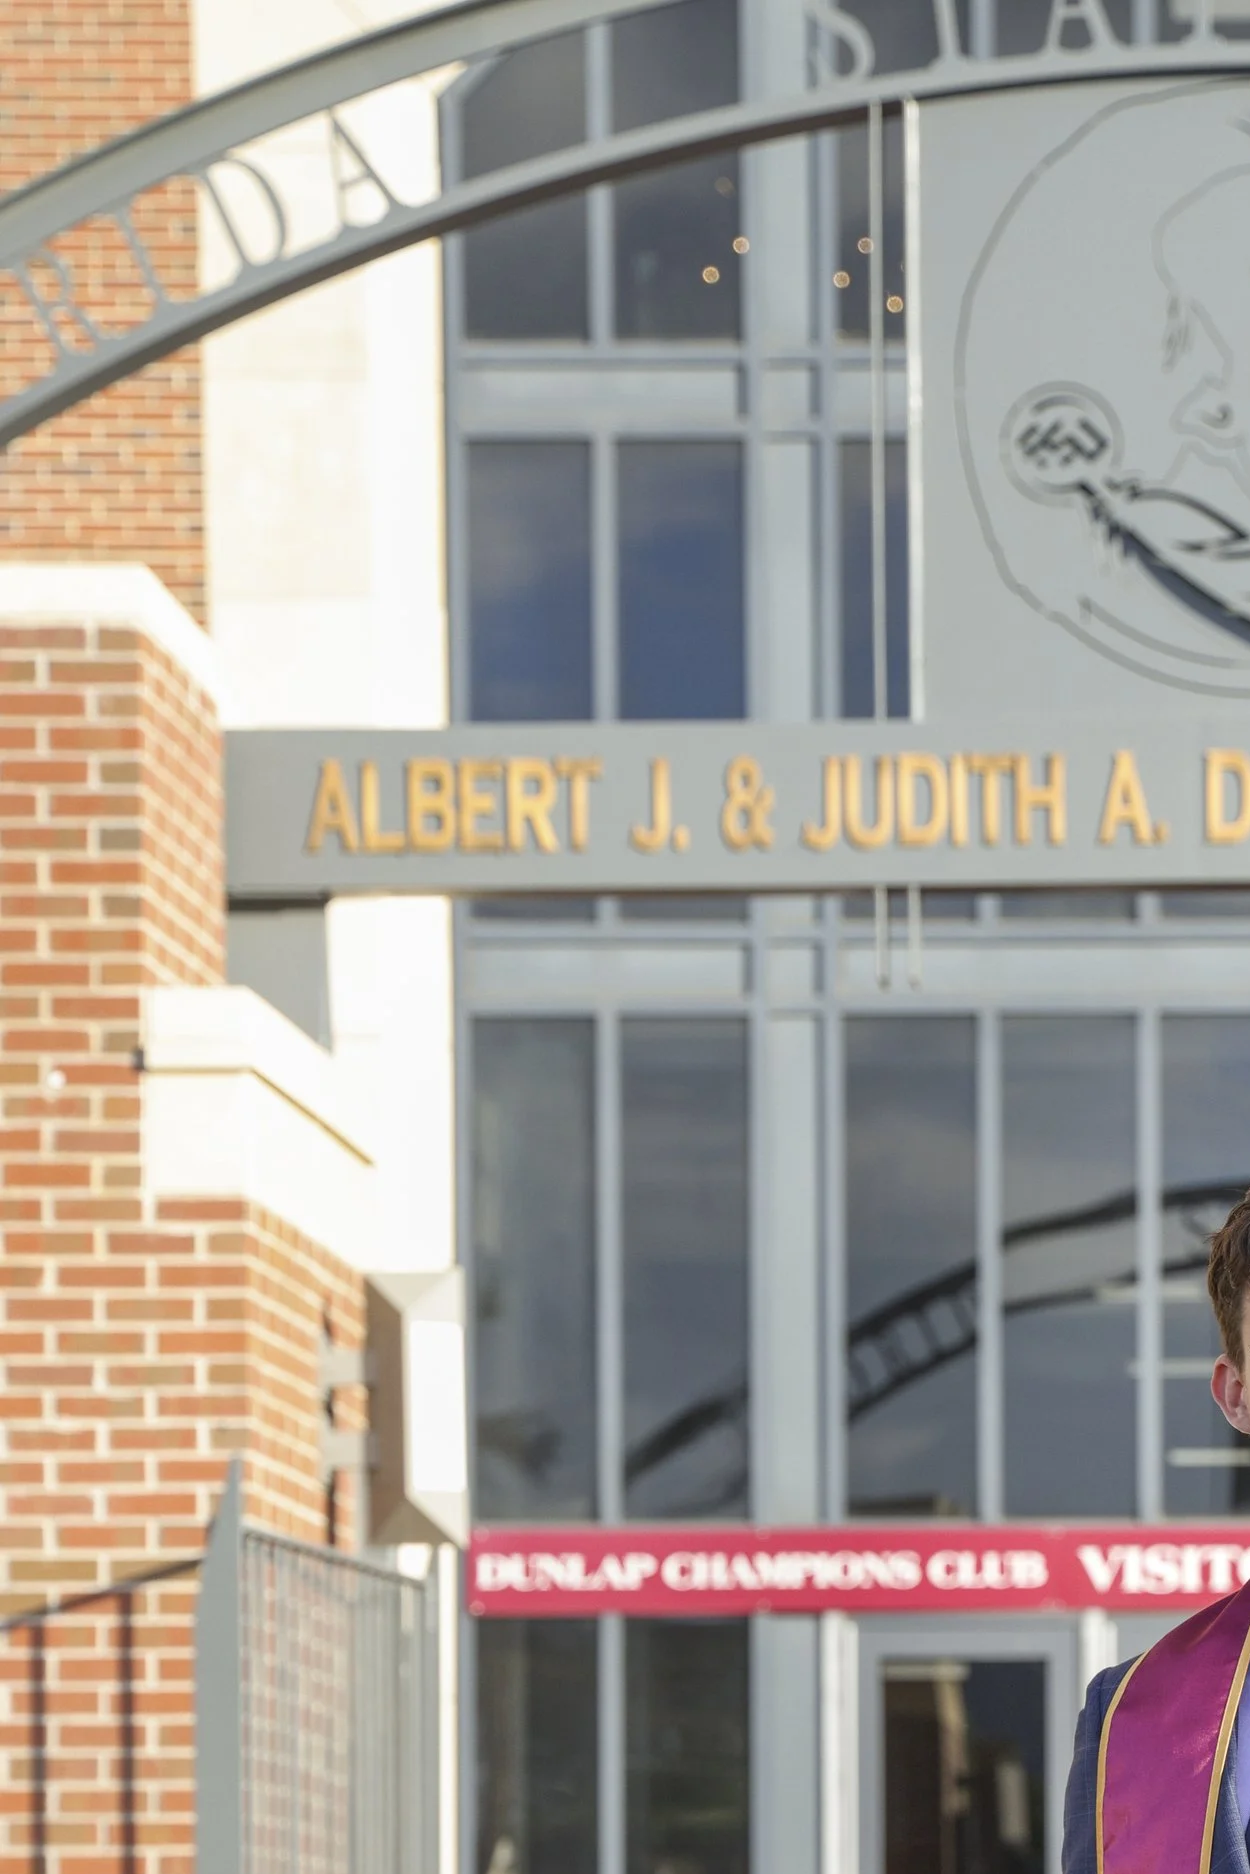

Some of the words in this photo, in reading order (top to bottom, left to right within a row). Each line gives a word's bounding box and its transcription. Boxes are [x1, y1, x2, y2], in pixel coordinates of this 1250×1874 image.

[305, 757, 603, 855] ALBERT
[630, 755, 691, 853] J.
[720, 753, 775, 851] &
[801, 752, 1066, 852] JUDITH
[1098, 748, 1168, 848] A.
[476, 1552, 659, 1592] DUNLAP
[661, 1550, 922, 1591] CHAMPIONS
[926, 1550, 1048, 1590] CLUB
